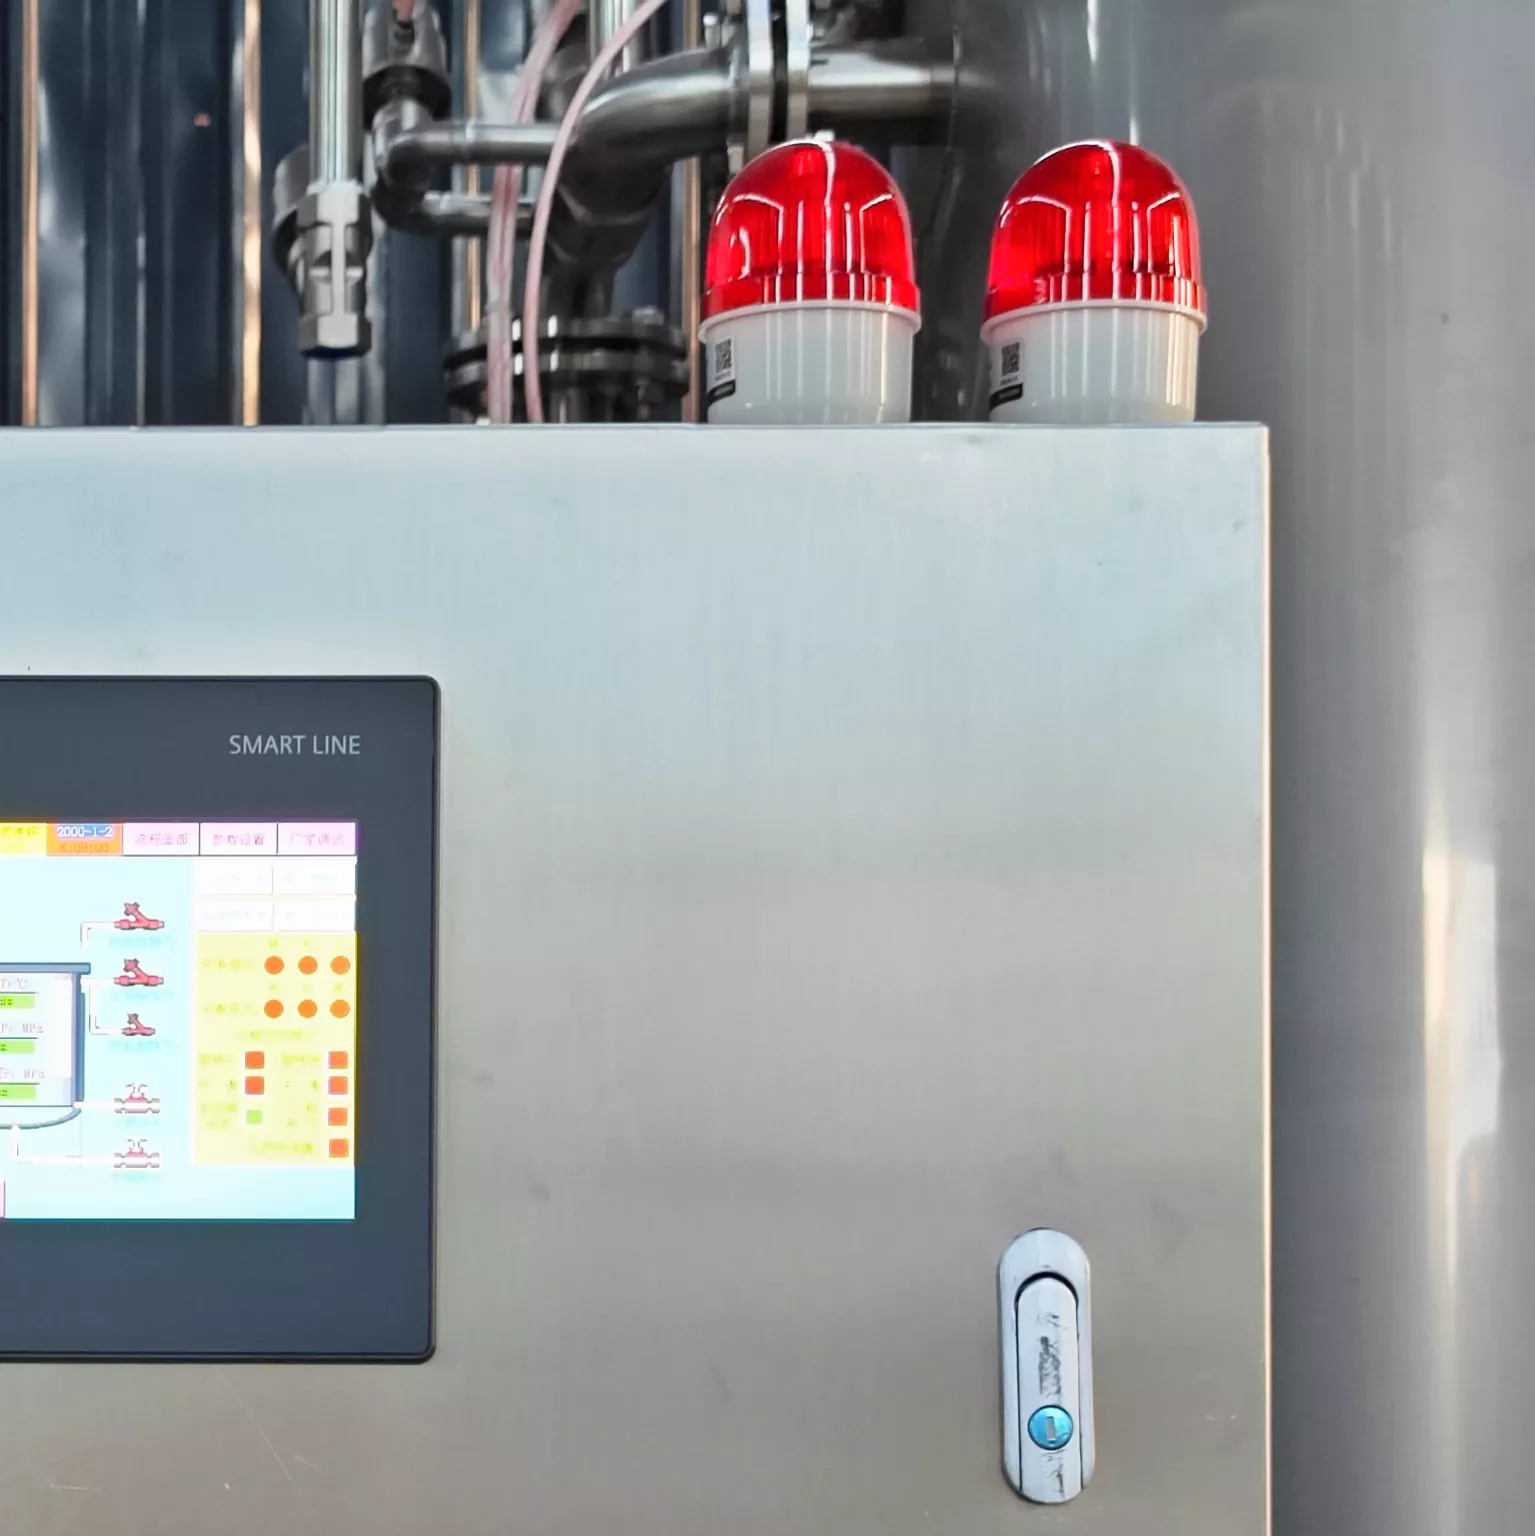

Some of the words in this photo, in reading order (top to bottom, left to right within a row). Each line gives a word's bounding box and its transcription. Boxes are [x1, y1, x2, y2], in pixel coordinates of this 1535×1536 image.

[229, 735, 305, 754] SMART
[313, 735, 360, 754] LINE
[57, 826, 113, 837] 2000-1-2
